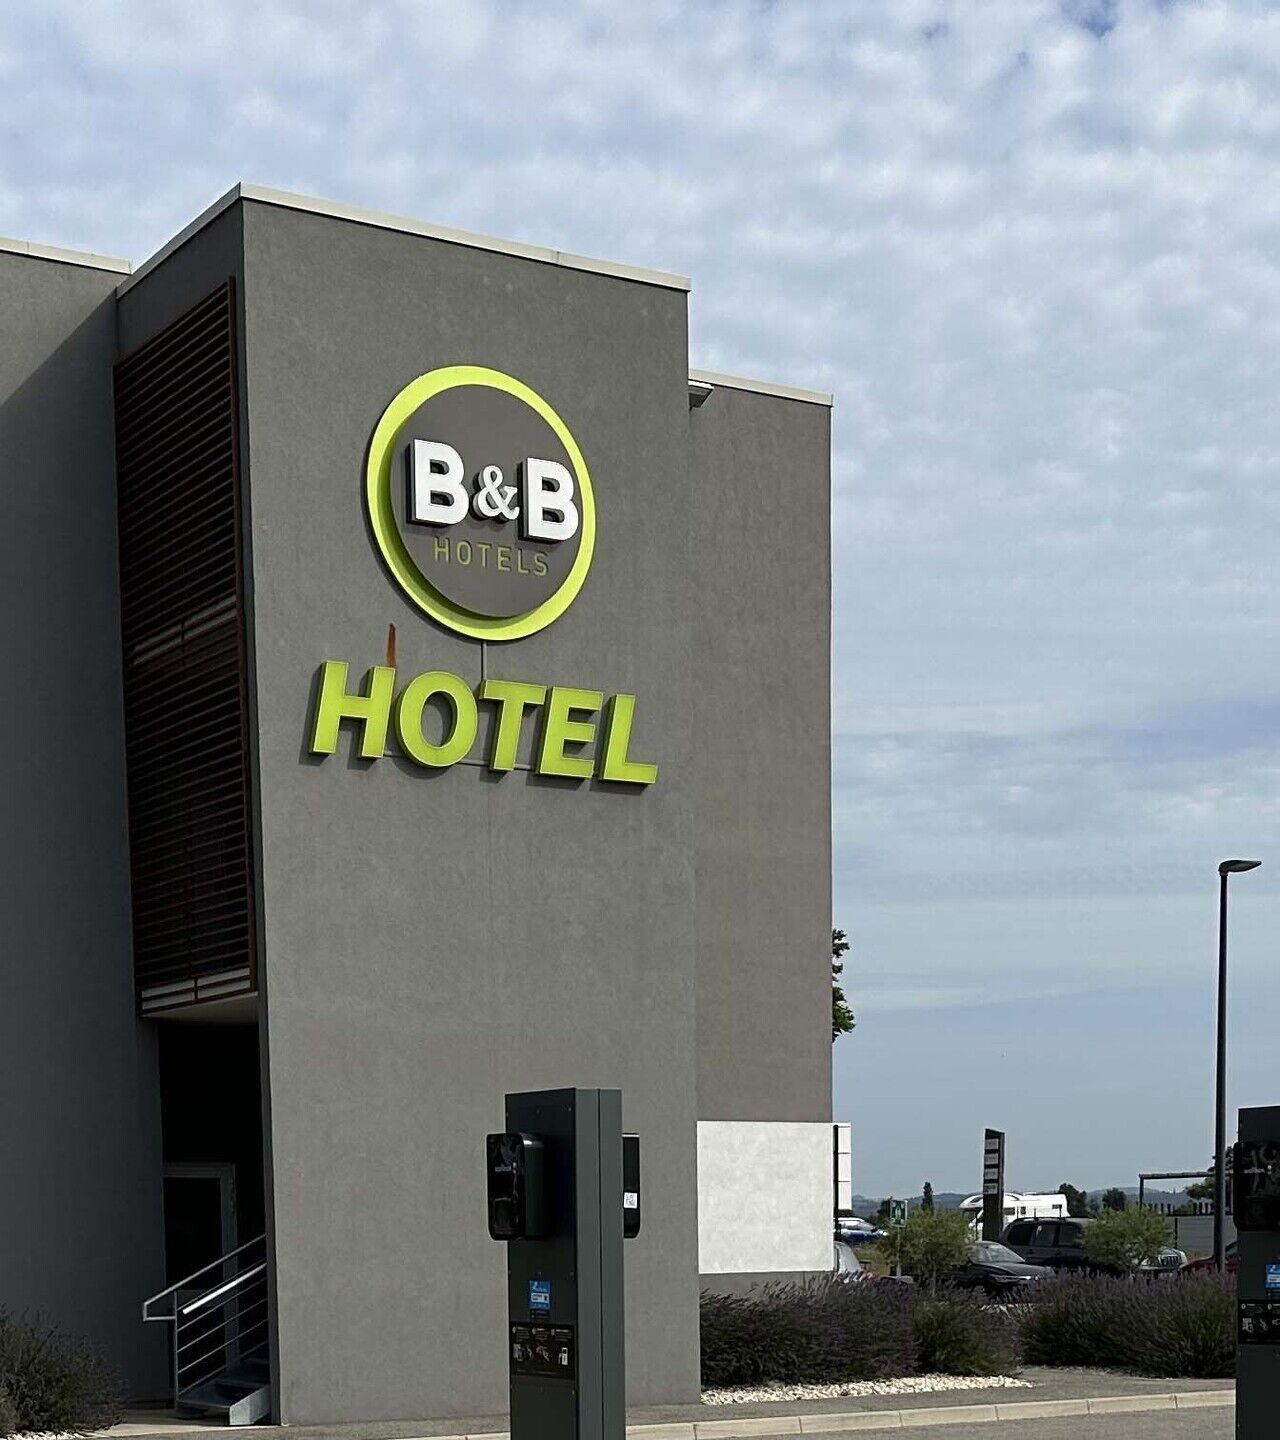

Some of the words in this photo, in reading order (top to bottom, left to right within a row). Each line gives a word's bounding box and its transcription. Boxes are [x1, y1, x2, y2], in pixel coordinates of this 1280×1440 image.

[410, 438, 579, 541] B&B
[433, 537, 550, 577] HOTELS
[310, 660, 658, 784] HOTEL
